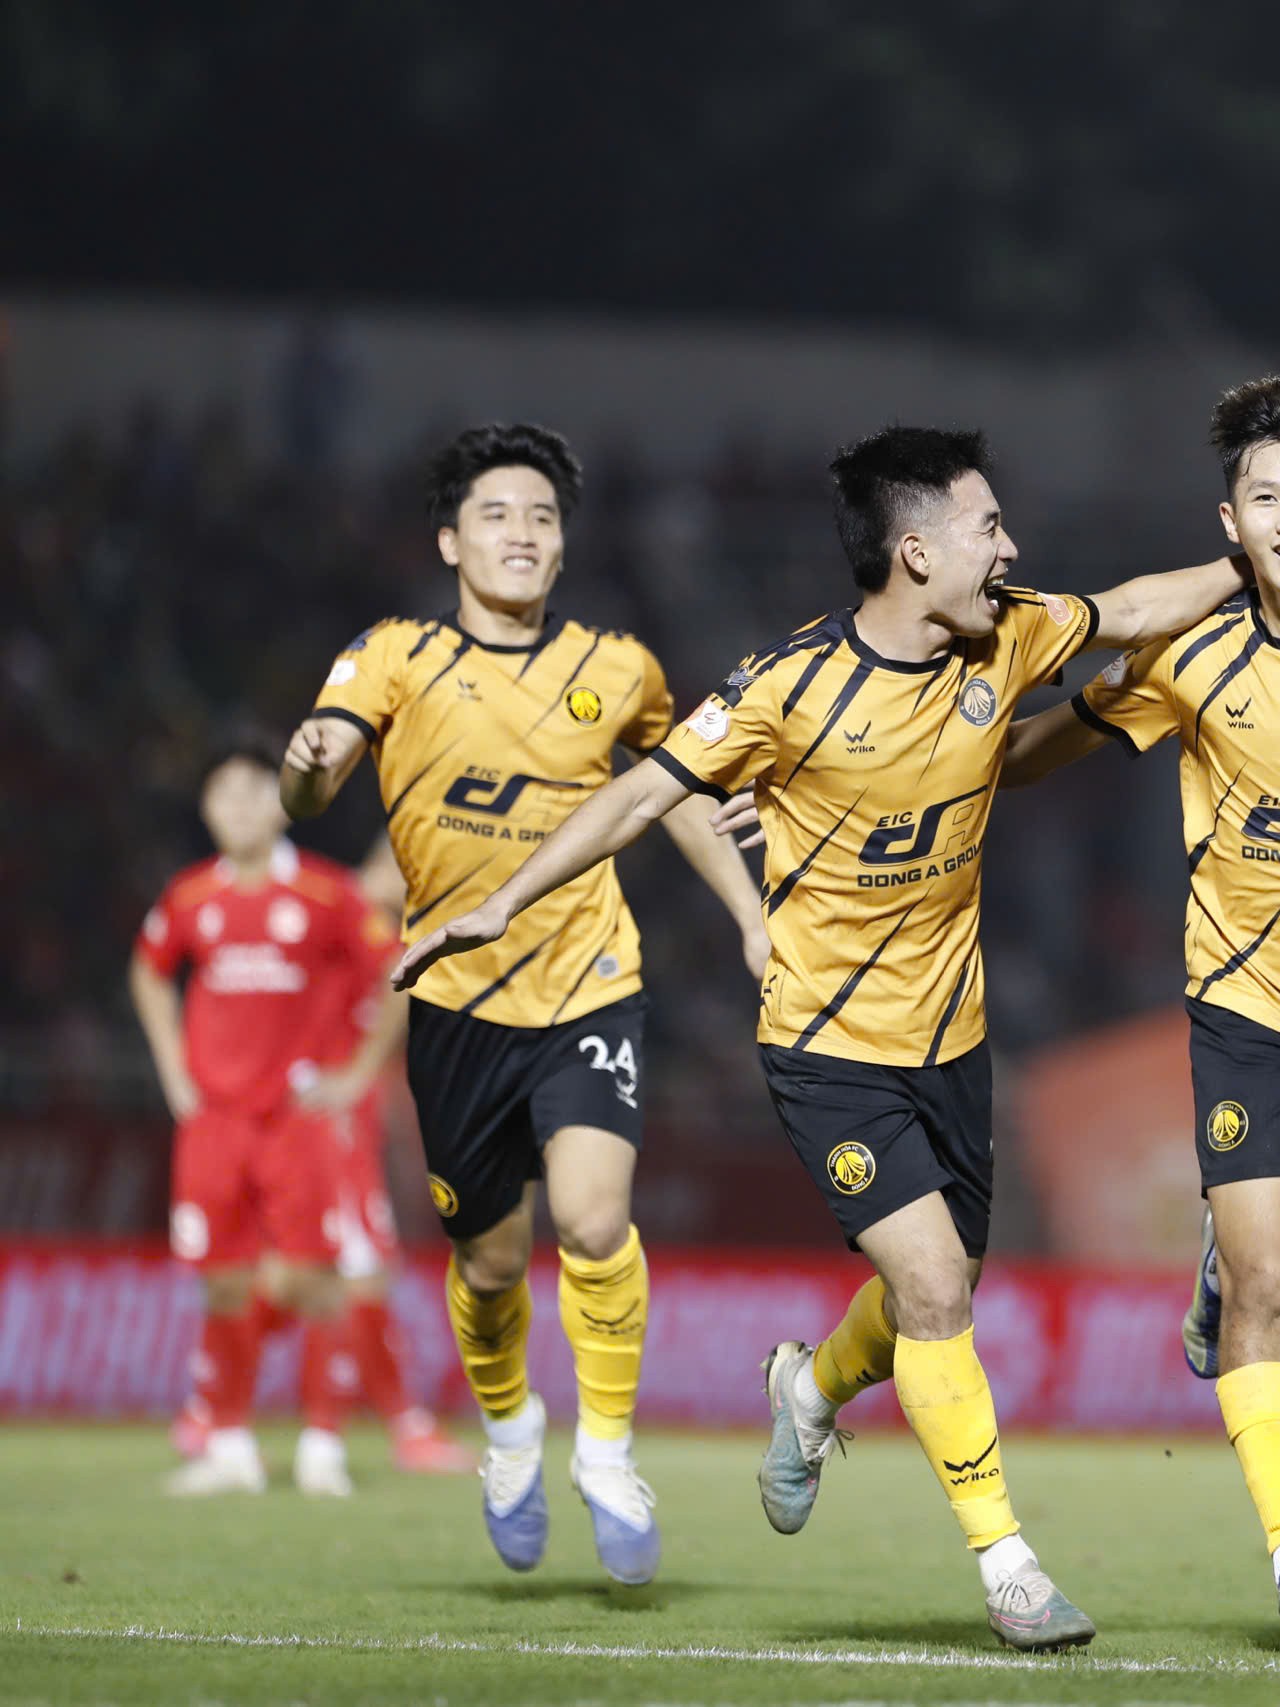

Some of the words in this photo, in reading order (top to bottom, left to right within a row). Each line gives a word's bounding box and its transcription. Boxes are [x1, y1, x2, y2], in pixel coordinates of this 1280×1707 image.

[876, 811, 913, 828] EIC
[500, 827, 512, 840] A
[925, 863, 940, 880] A
[578, 1034, 638, 1083] 24
